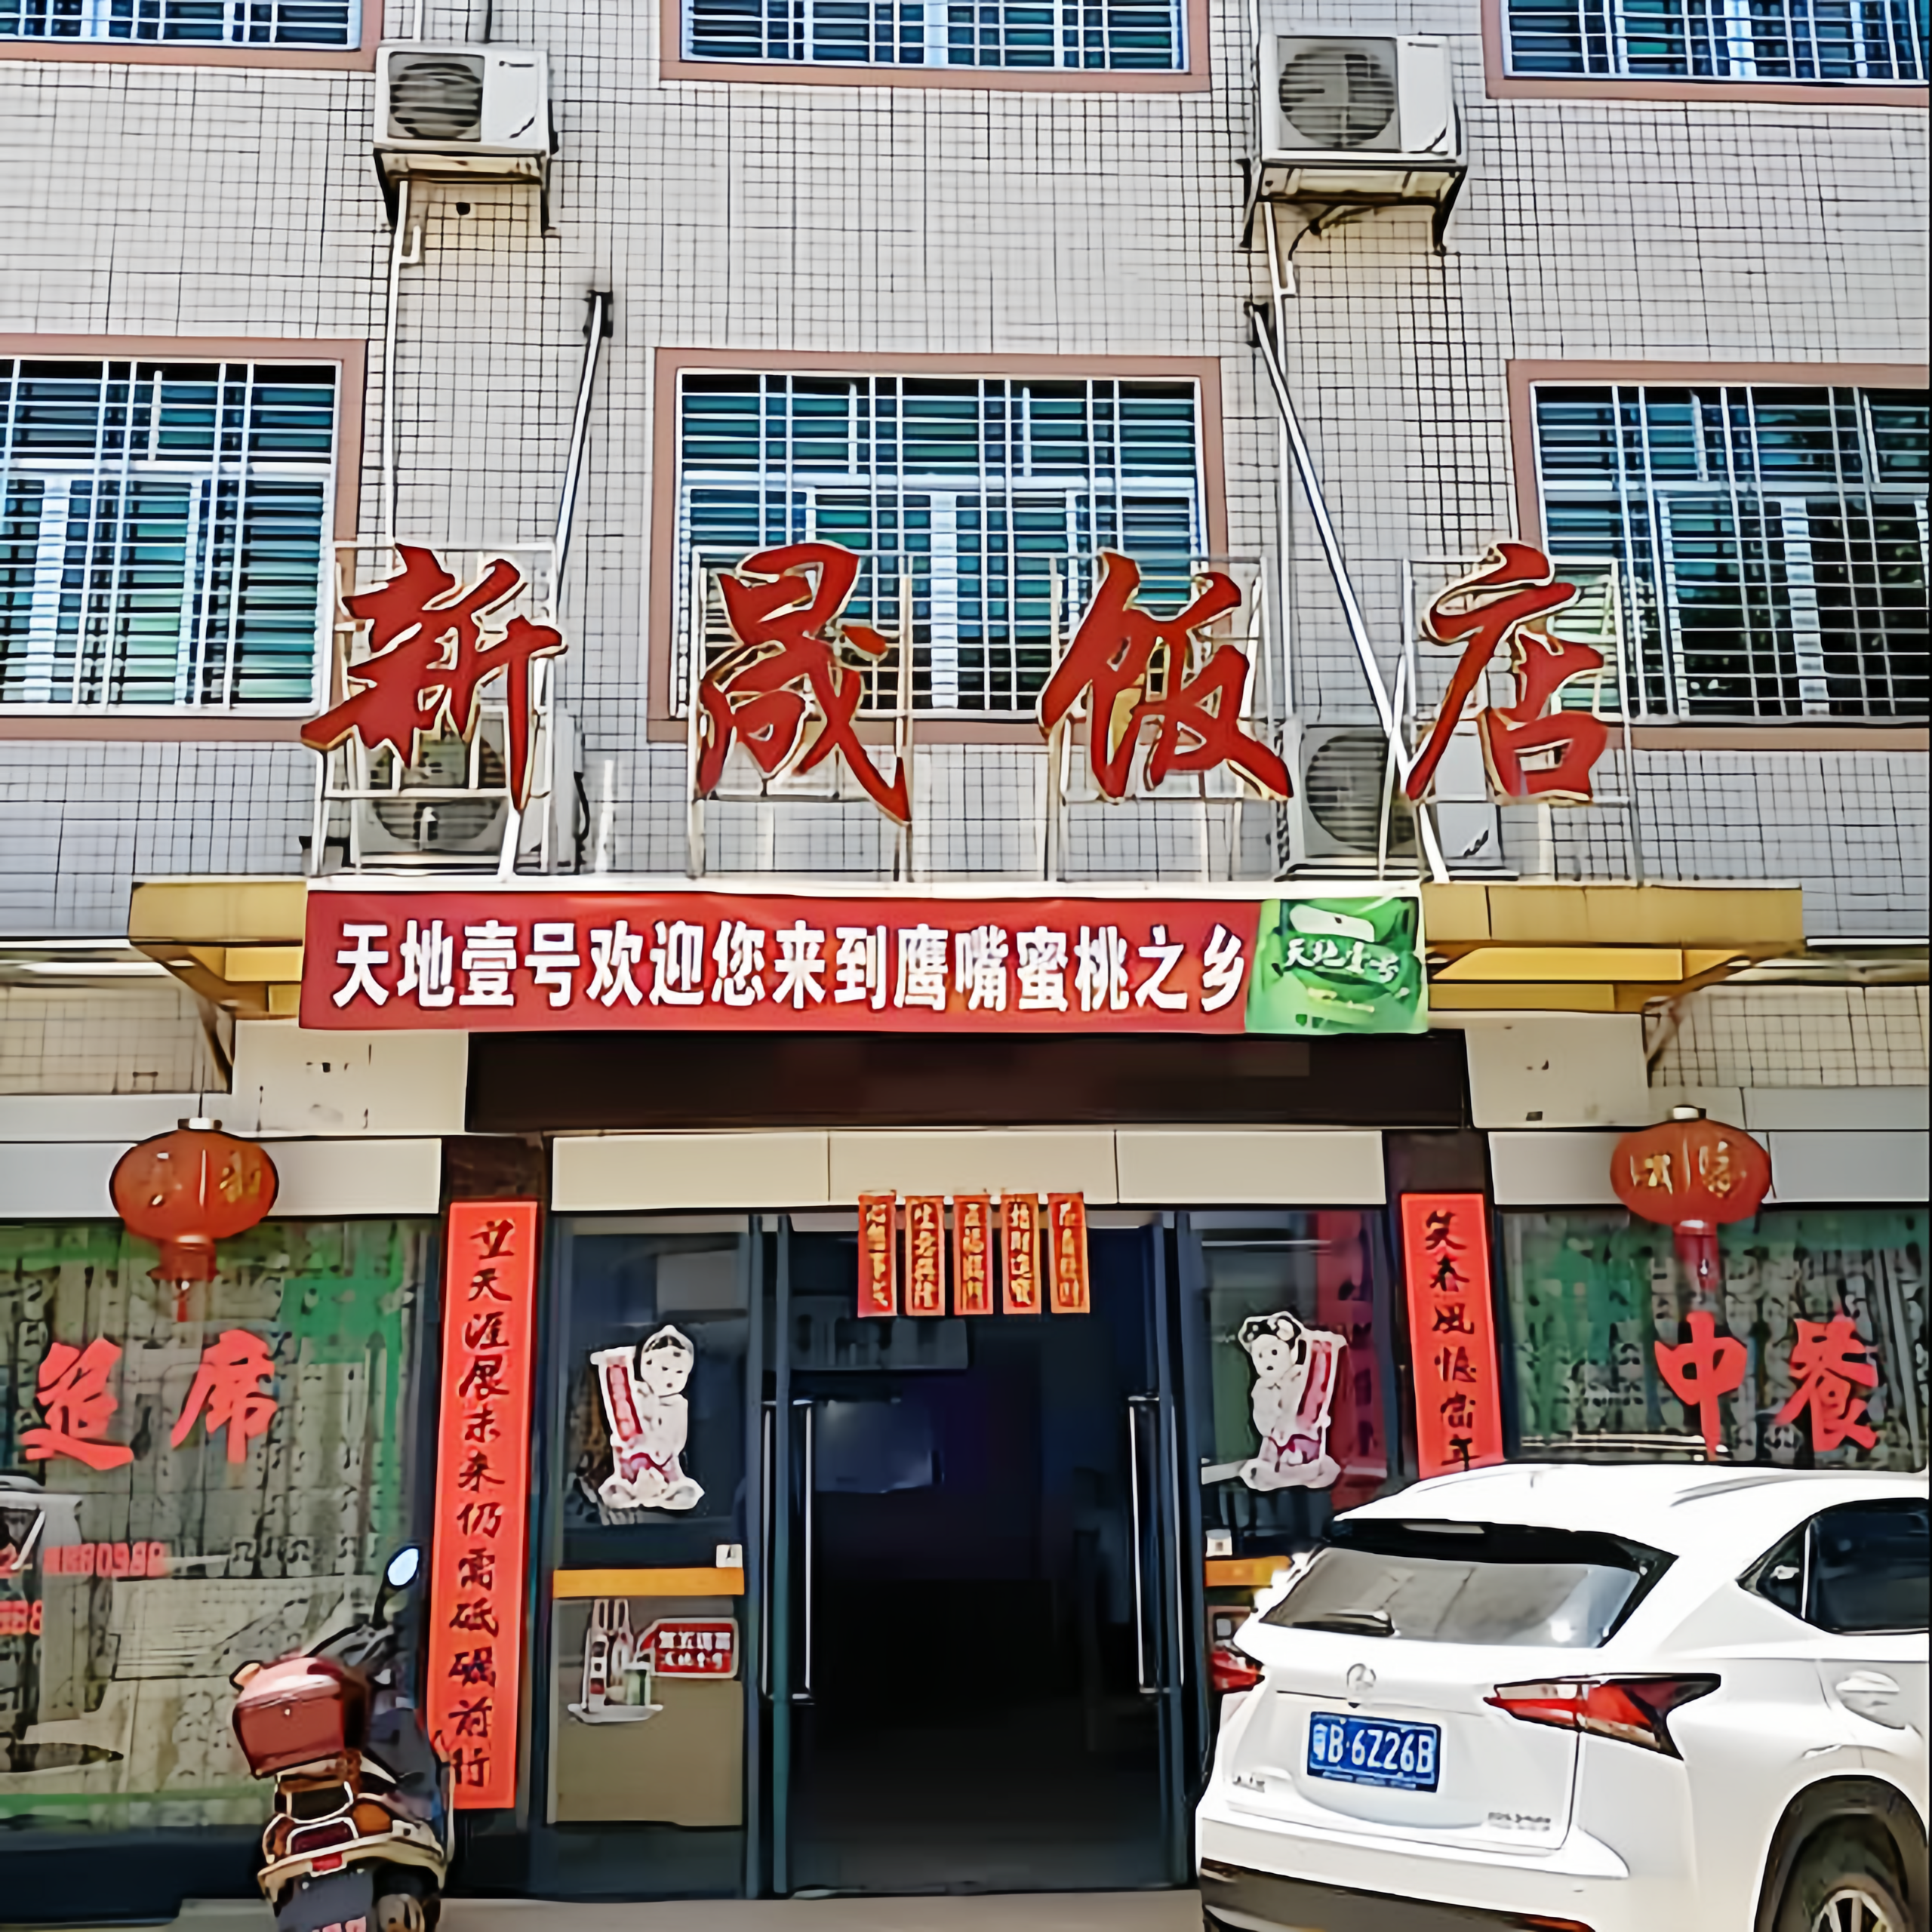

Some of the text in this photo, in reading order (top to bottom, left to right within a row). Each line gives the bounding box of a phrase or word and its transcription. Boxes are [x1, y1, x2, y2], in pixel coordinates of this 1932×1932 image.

[331, 918, 1245, 1012] 天地壹号欢迎您来到鹰嘴蜜桃之乡
